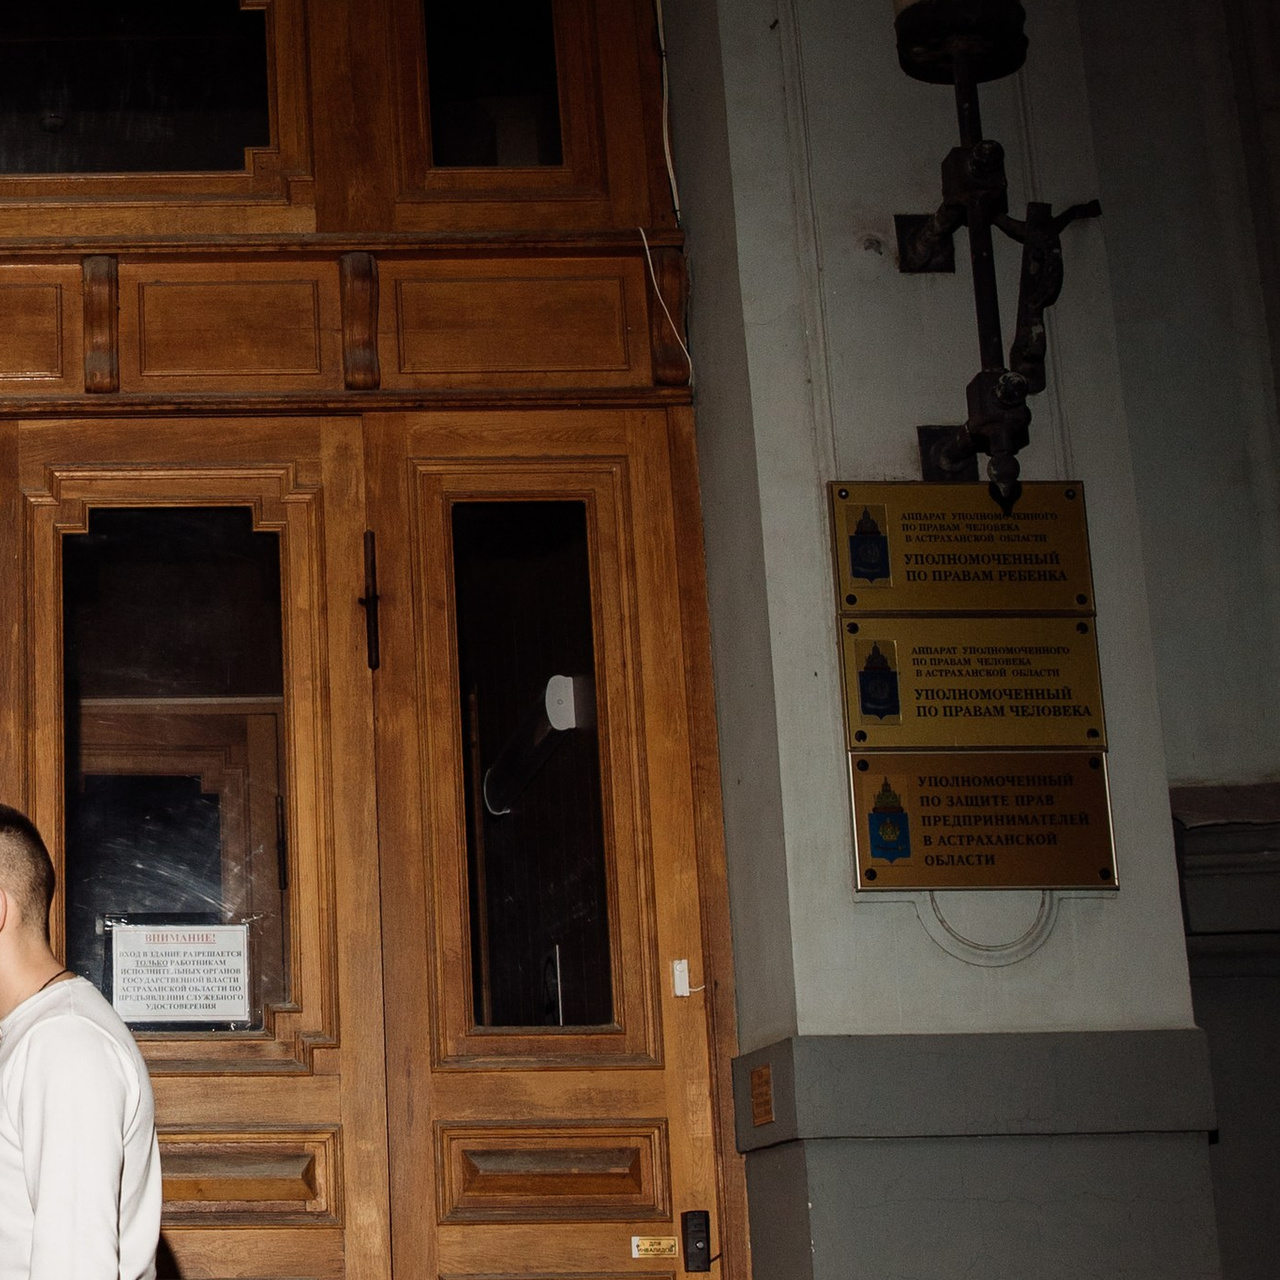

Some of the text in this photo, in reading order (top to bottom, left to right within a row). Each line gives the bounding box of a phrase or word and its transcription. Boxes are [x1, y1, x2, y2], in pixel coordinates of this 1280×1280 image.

[901, 513, 947, 521] АППАРАТ
[905, 533, 1047, 542] В АСТРАХАНСКОЙ ОБЛАСТИ
[904, 552, 1060, 565] УПОЛНОМОЧЕННЫЙ
[906, 570, 1067, 581] ПО ПРАВАМ РЕБЕНКА
[911, 646, 1070, 655] АППАРАТ УПОЛНОМОЧЕННОГО
[912, 658, 1031, 666] ПО ПРАВАМ ЧЕЛОВЕКА
[916, 668, 1060, 677] В АСТРАХАНСКОЙ ОБЛАСТИ
[914, 686, 1072, 701] УПОЛНОМОЧЕННЫЙ
[916, 705, 1092, 717] ПО ПРАВАМ ЧЕЛОВЕКА
[918, 774, 1073, 787] УПОЛНОМОЧЕННЫЙ
[919, 795, 1054, 807] ПО ЗАЩИТЕ ПРАВ
[921, 812, 1090, 828] ПРЕДПРИНИМАТЕЛЕЙ
[923, 832, 1058, 846] В АСТРАХАНСКОЙ
[924, 854, 996, 866] ОБЛАСТИ
[145, 933, 216, 943] ВНИМАНИЕ!
